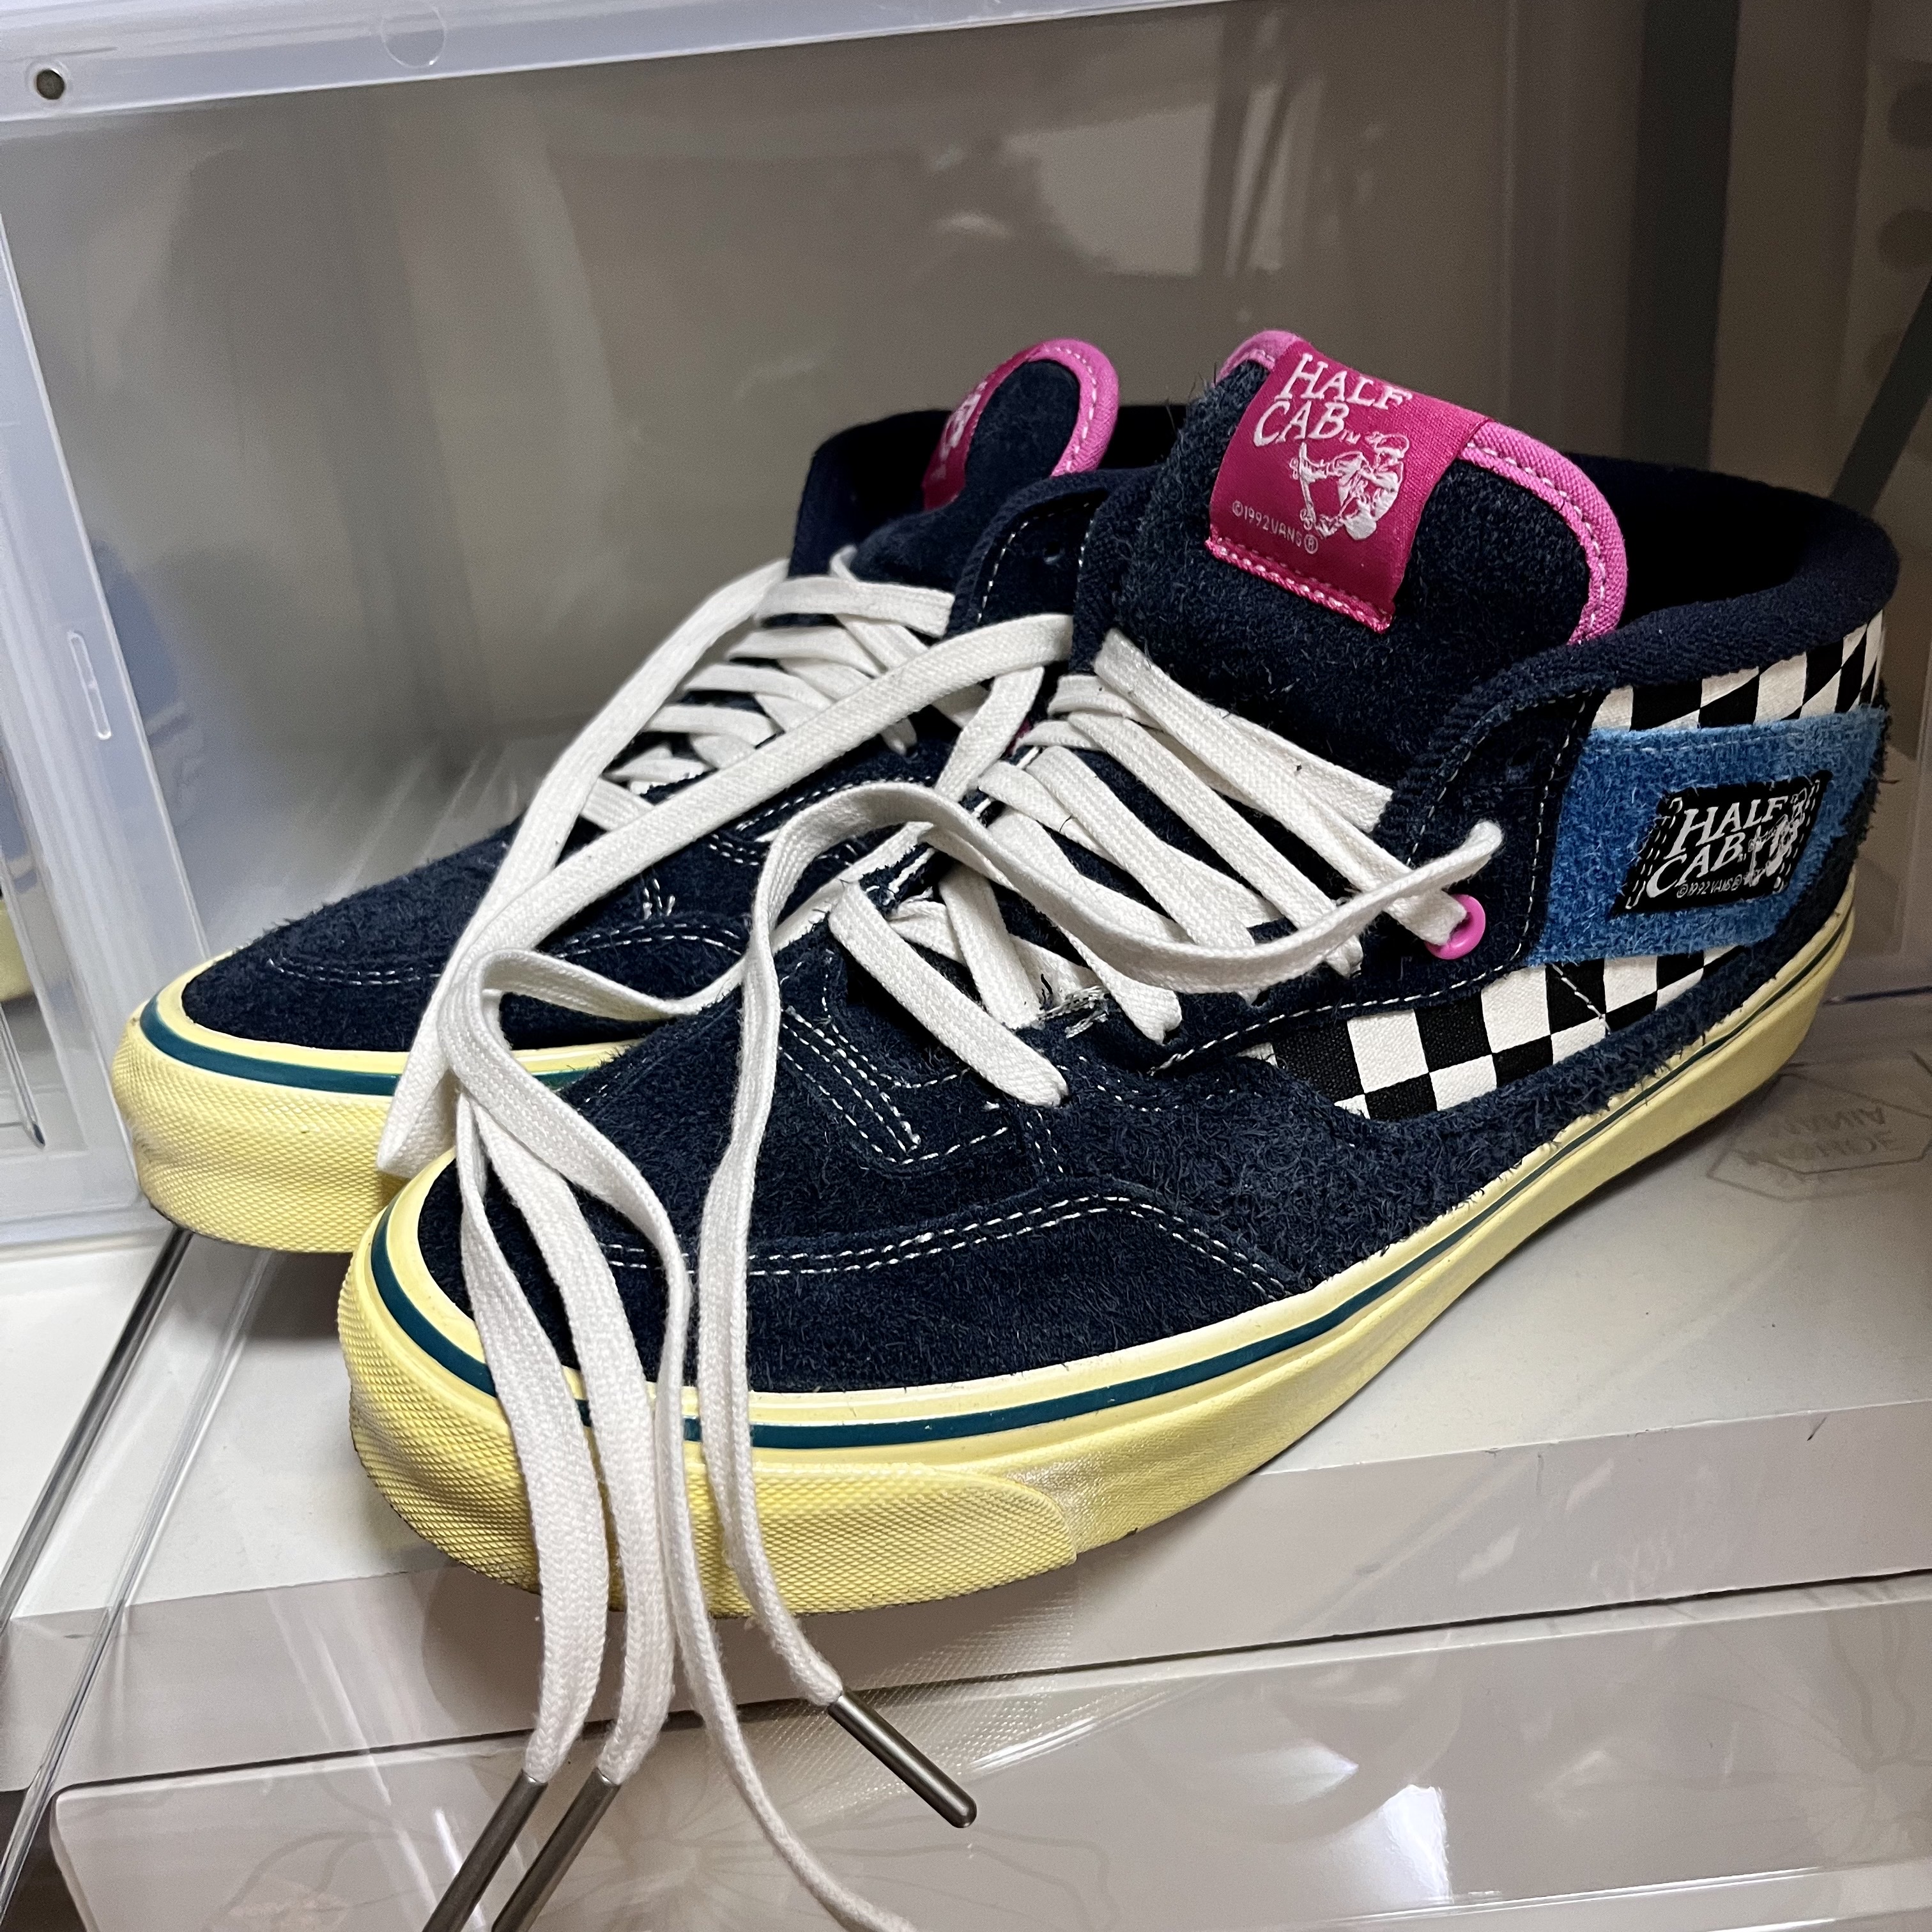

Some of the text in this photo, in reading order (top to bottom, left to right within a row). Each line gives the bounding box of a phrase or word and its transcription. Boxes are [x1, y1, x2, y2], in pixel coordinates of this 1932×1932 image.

[1274, 353, 1412, 410] HALF
[1253, 399, 1349, 447] CAB
[1663, 796, 1788, 859] HALF
[1646, 832, 1746, 898] CAB
